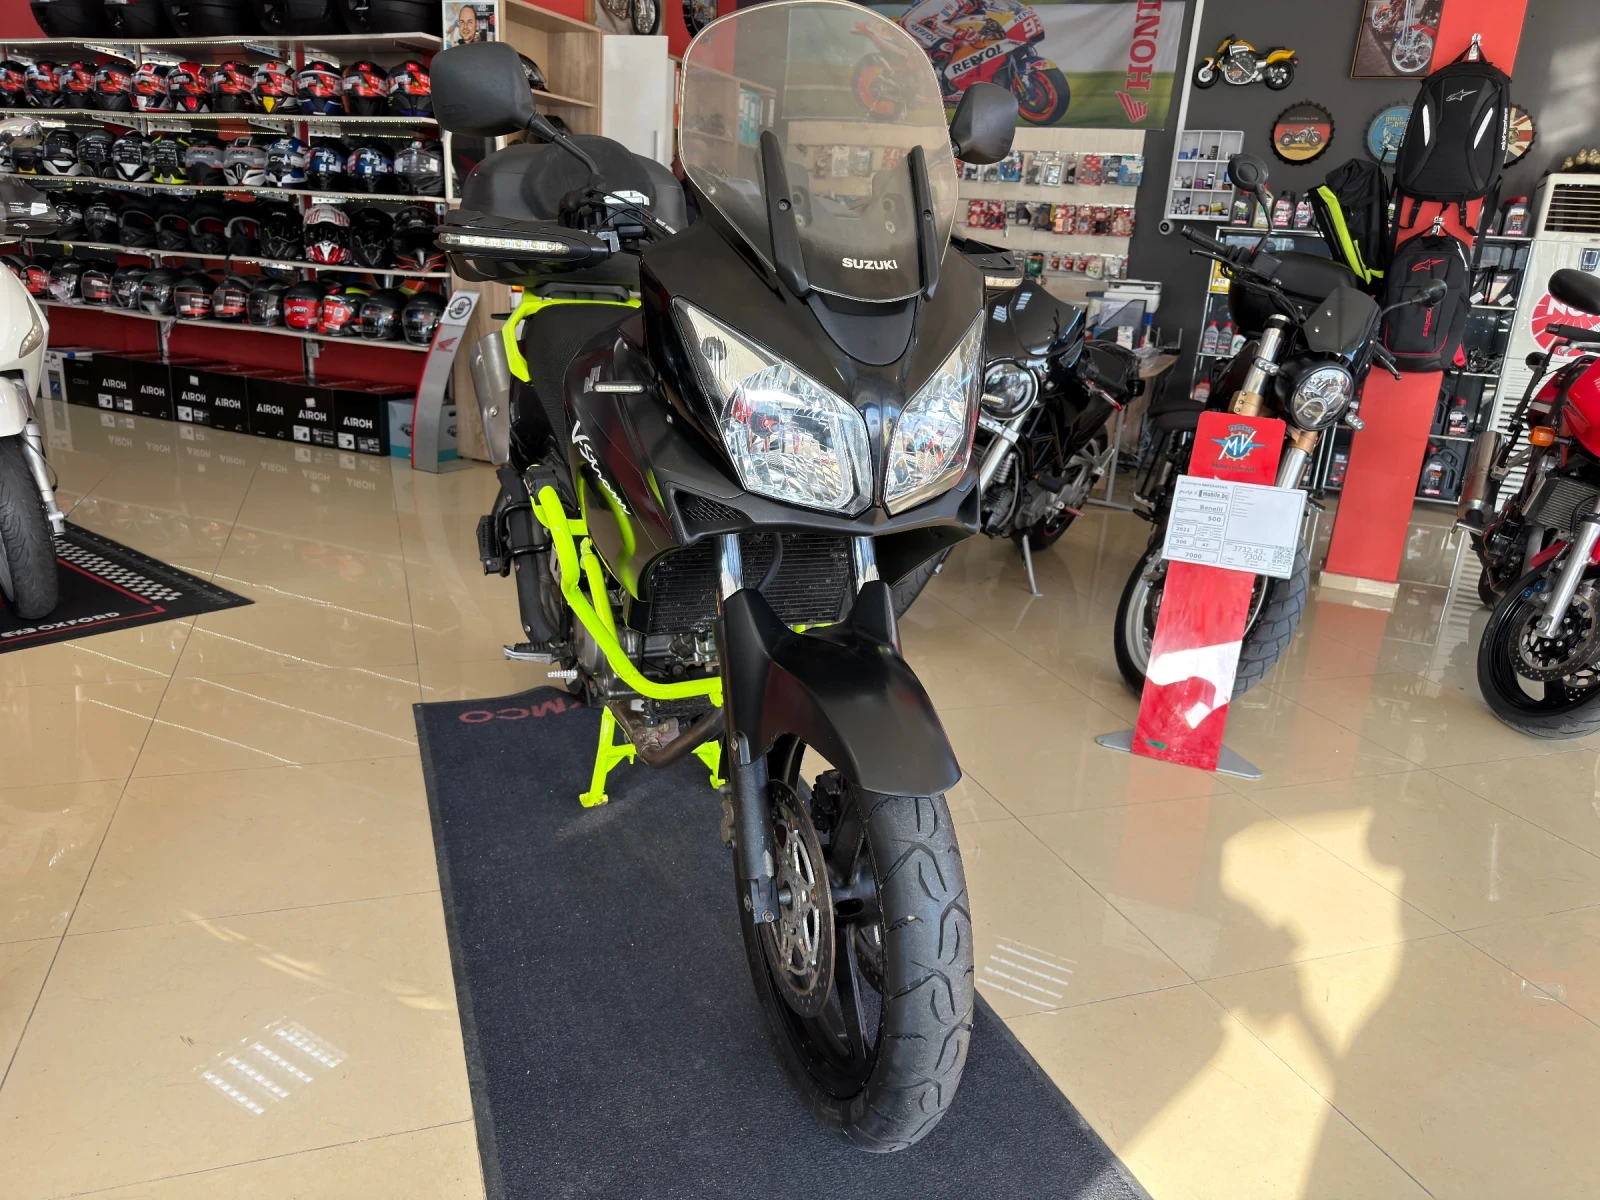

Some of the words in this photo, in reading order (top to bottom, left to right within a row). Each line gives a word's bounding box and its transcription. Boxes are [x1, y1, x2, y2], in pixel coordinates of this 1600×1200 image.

[952, 44, 1004, 75] REPSOL
[842, 257, 898, 270] SUZUKI
[102, 378, 127, 390] AIROH
[140, 384, 165, 397] AIROH
[181, 391, 206, 403] AIROH
[215, 397, 241, 409] AIROH
[256, 403, 284, 416] AIROH
[298, 409, 327, 422] AIROH
[343, 416, 373, 429] AIROH
[1218, 430, 1257, 460] MV
[1200, 504, 1224, 513] Benelli
[1208, 515, 1221, 523] 500
[1185, 552, 1202, 560] 7000
[1243, 552, 1263, 562] 7300
[38, 612, 121, 631] OXFORD
[459, 697, 582, 723] MCO
